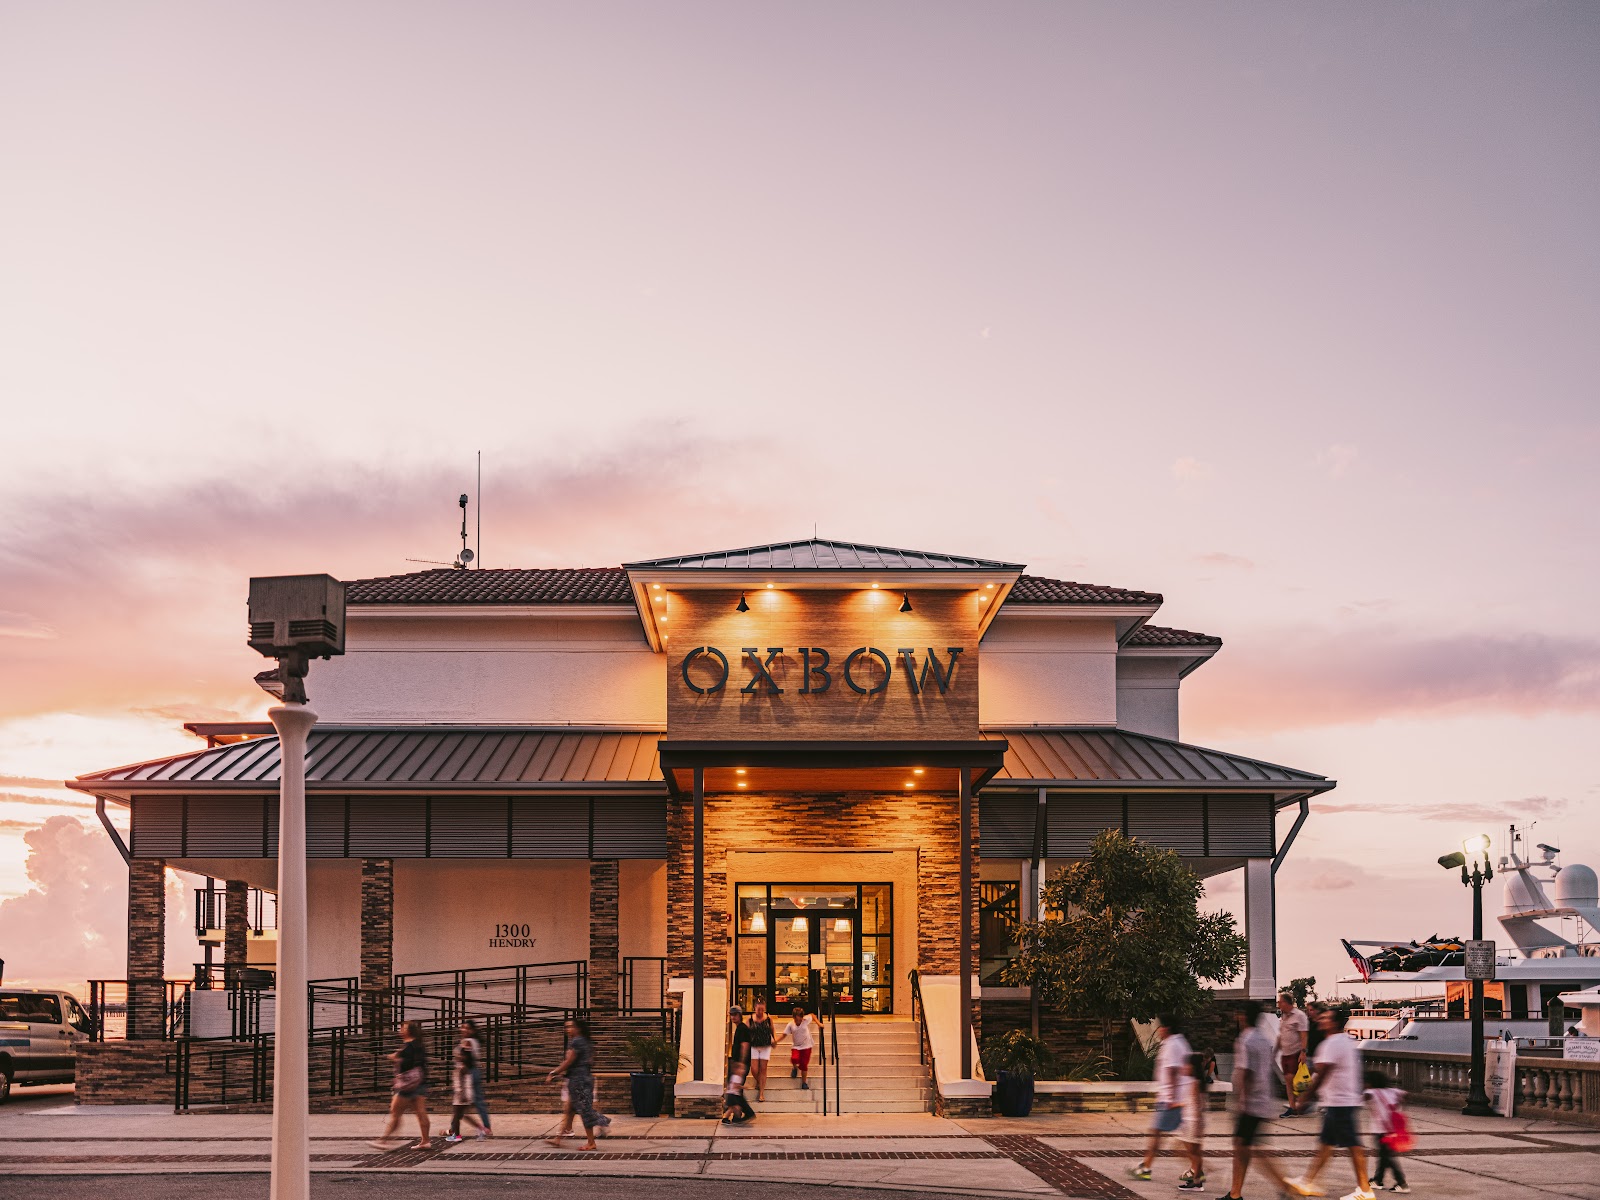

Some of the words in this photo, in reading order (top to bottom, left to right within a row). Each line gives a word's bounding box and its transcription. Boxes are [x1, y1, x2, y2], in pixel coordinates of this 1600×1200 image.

[682, 646, 964, 694] OXBOW
[495, 924, 530, 937] 1300
[489, 938, 537, 948] HENDRY
